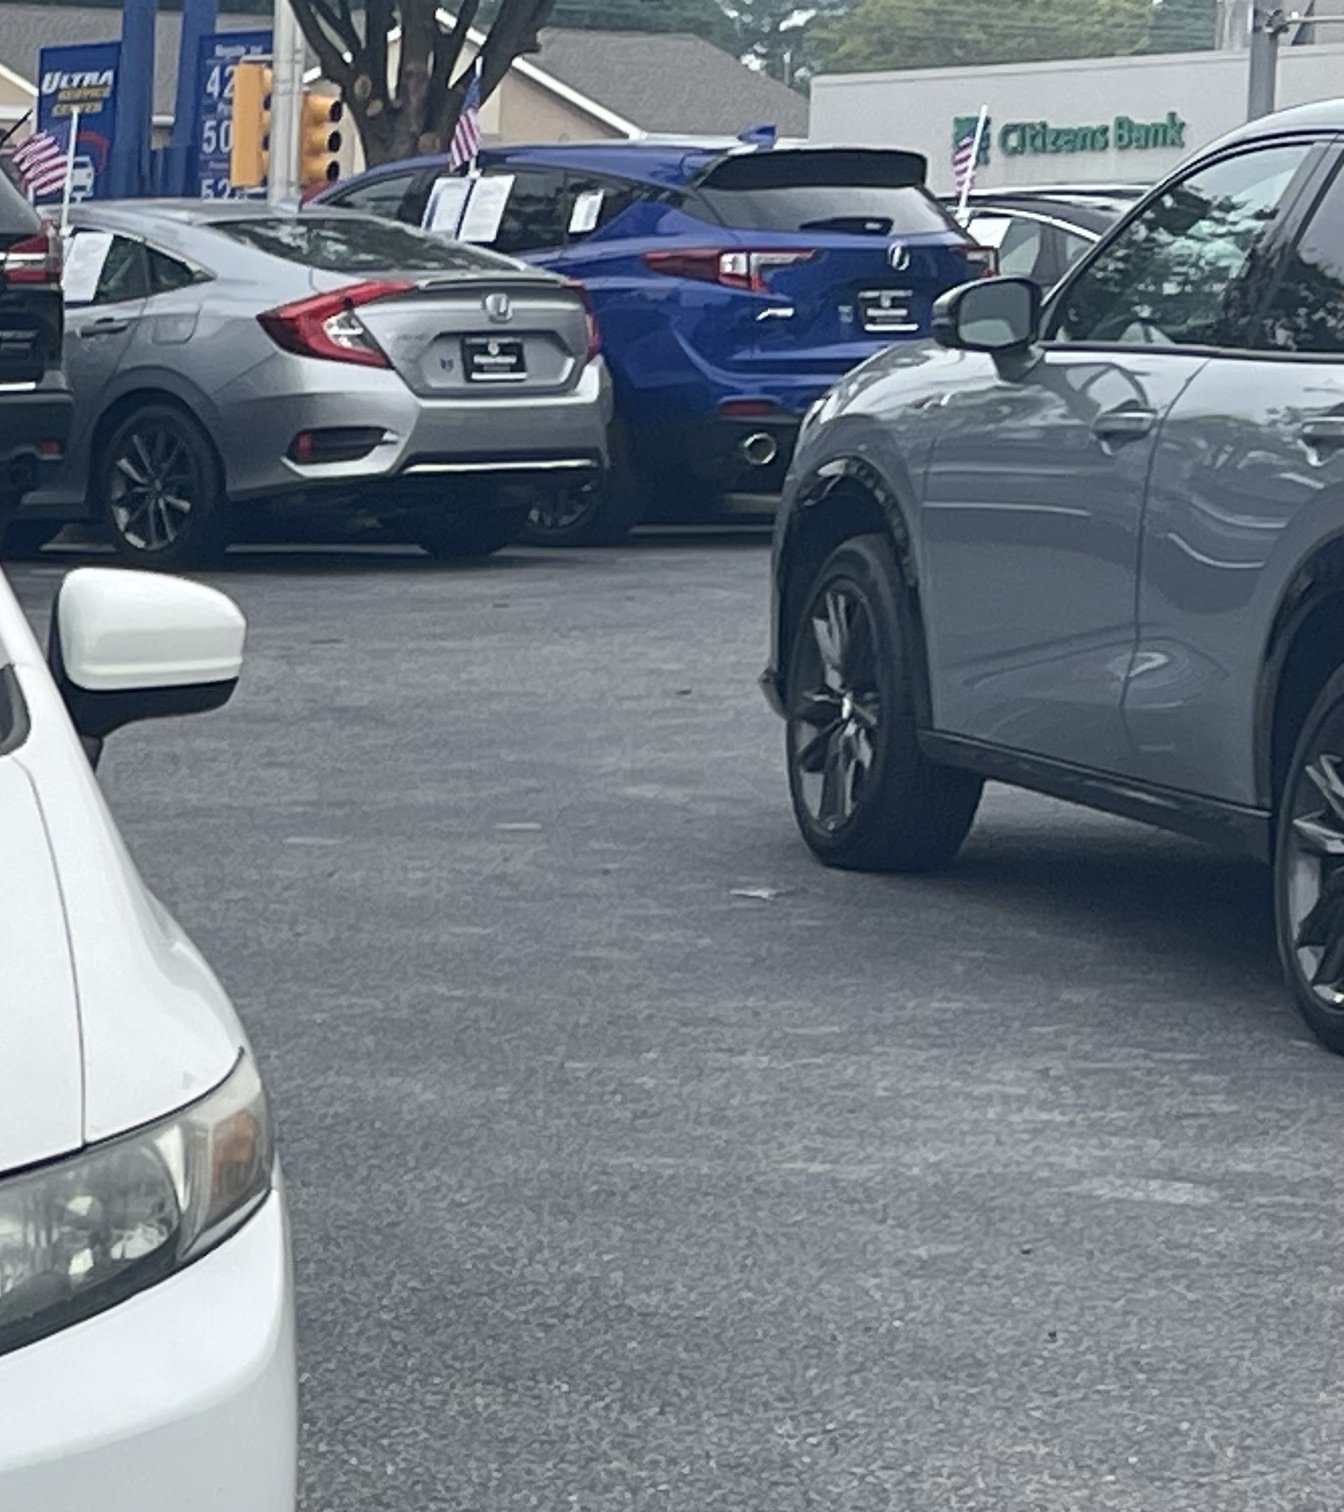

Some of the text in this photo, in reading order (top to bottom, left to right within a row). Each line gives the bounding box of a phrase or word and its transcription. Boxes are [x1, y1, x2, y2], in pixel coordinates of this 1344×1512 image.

[41, 69, 114, 95] ULTRA
[998, 111, 1186, 156] Citizens Bank
